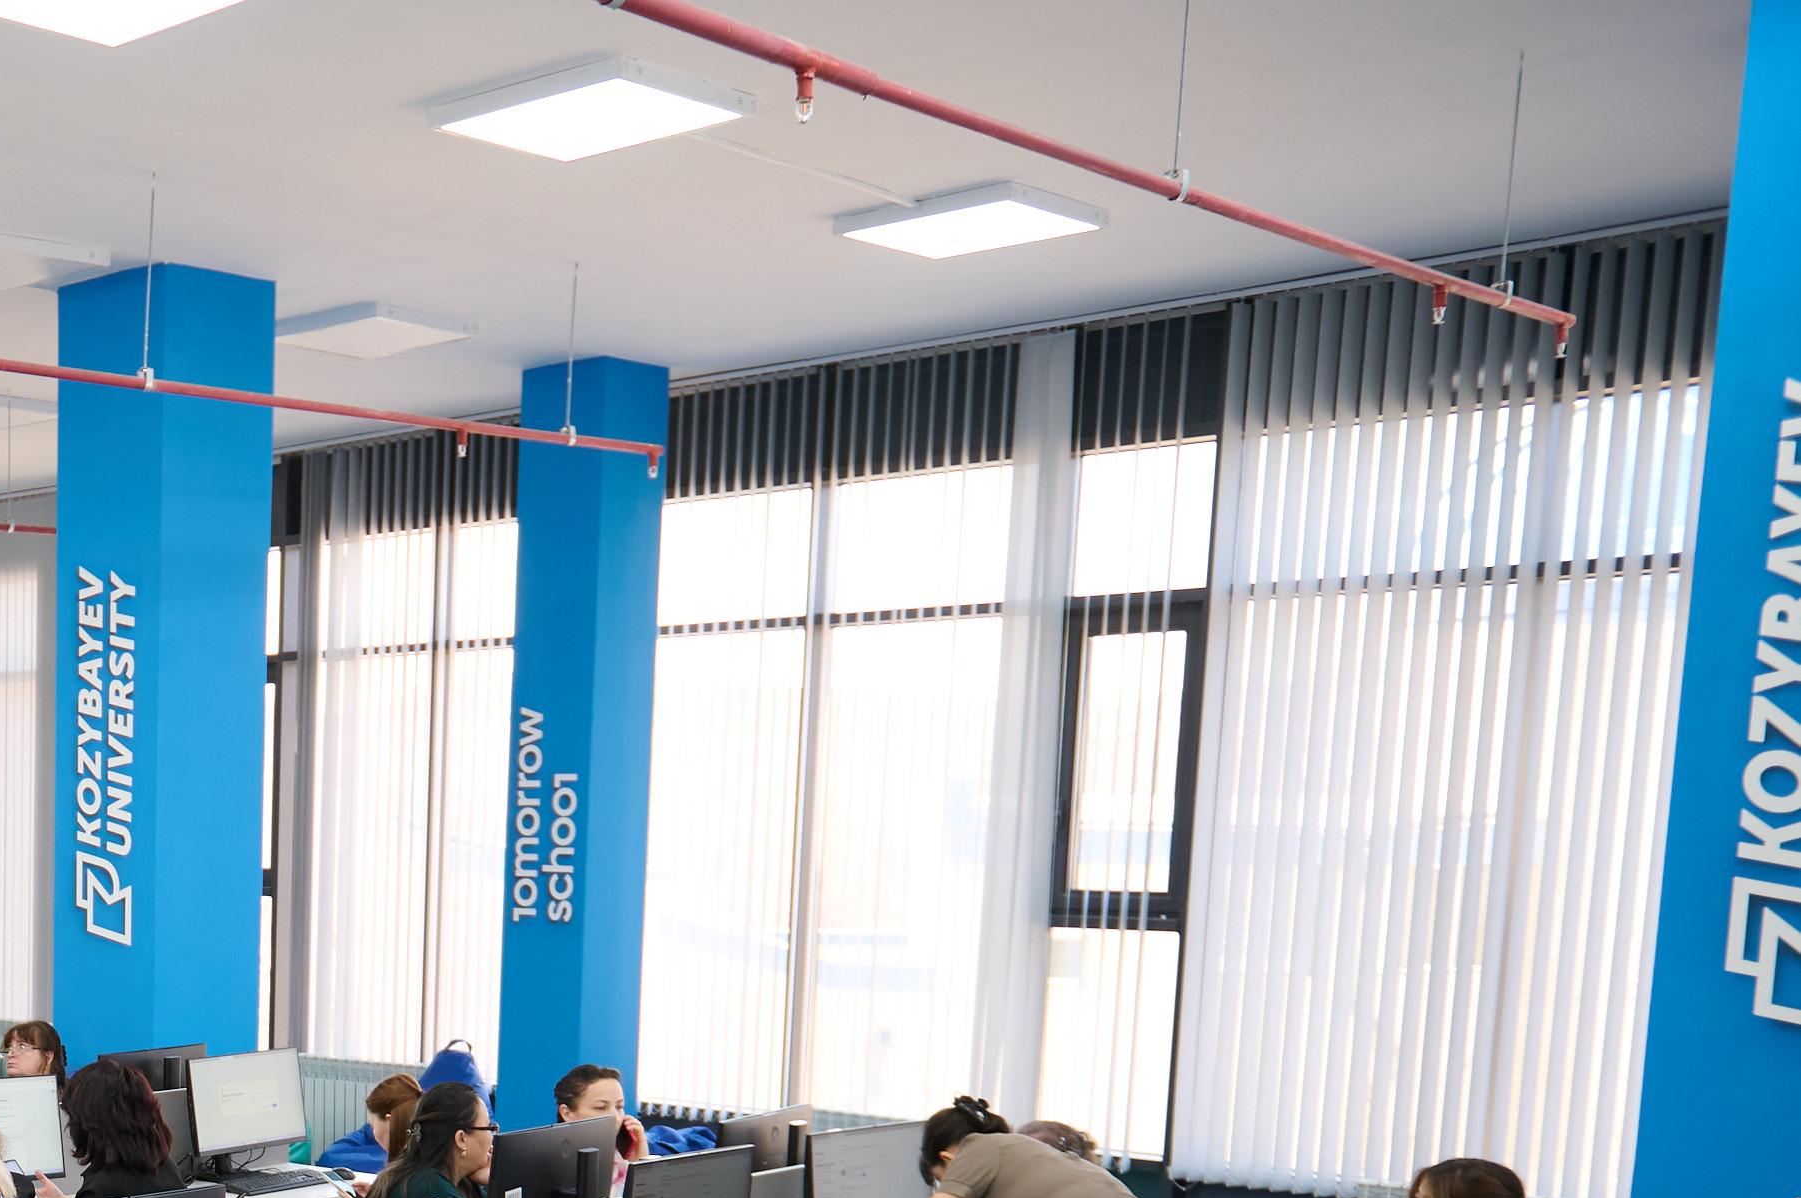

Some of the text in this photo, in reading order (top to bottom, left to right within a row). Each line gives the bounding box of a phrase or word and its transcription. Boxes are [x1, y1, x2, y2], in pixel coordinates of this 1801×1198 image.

[76, 565, 104, 848] KOZYBAYEV
[106, 570, 136, 857] UNIVERSITY
[1736, 376, 1801, 868] KOZYB
